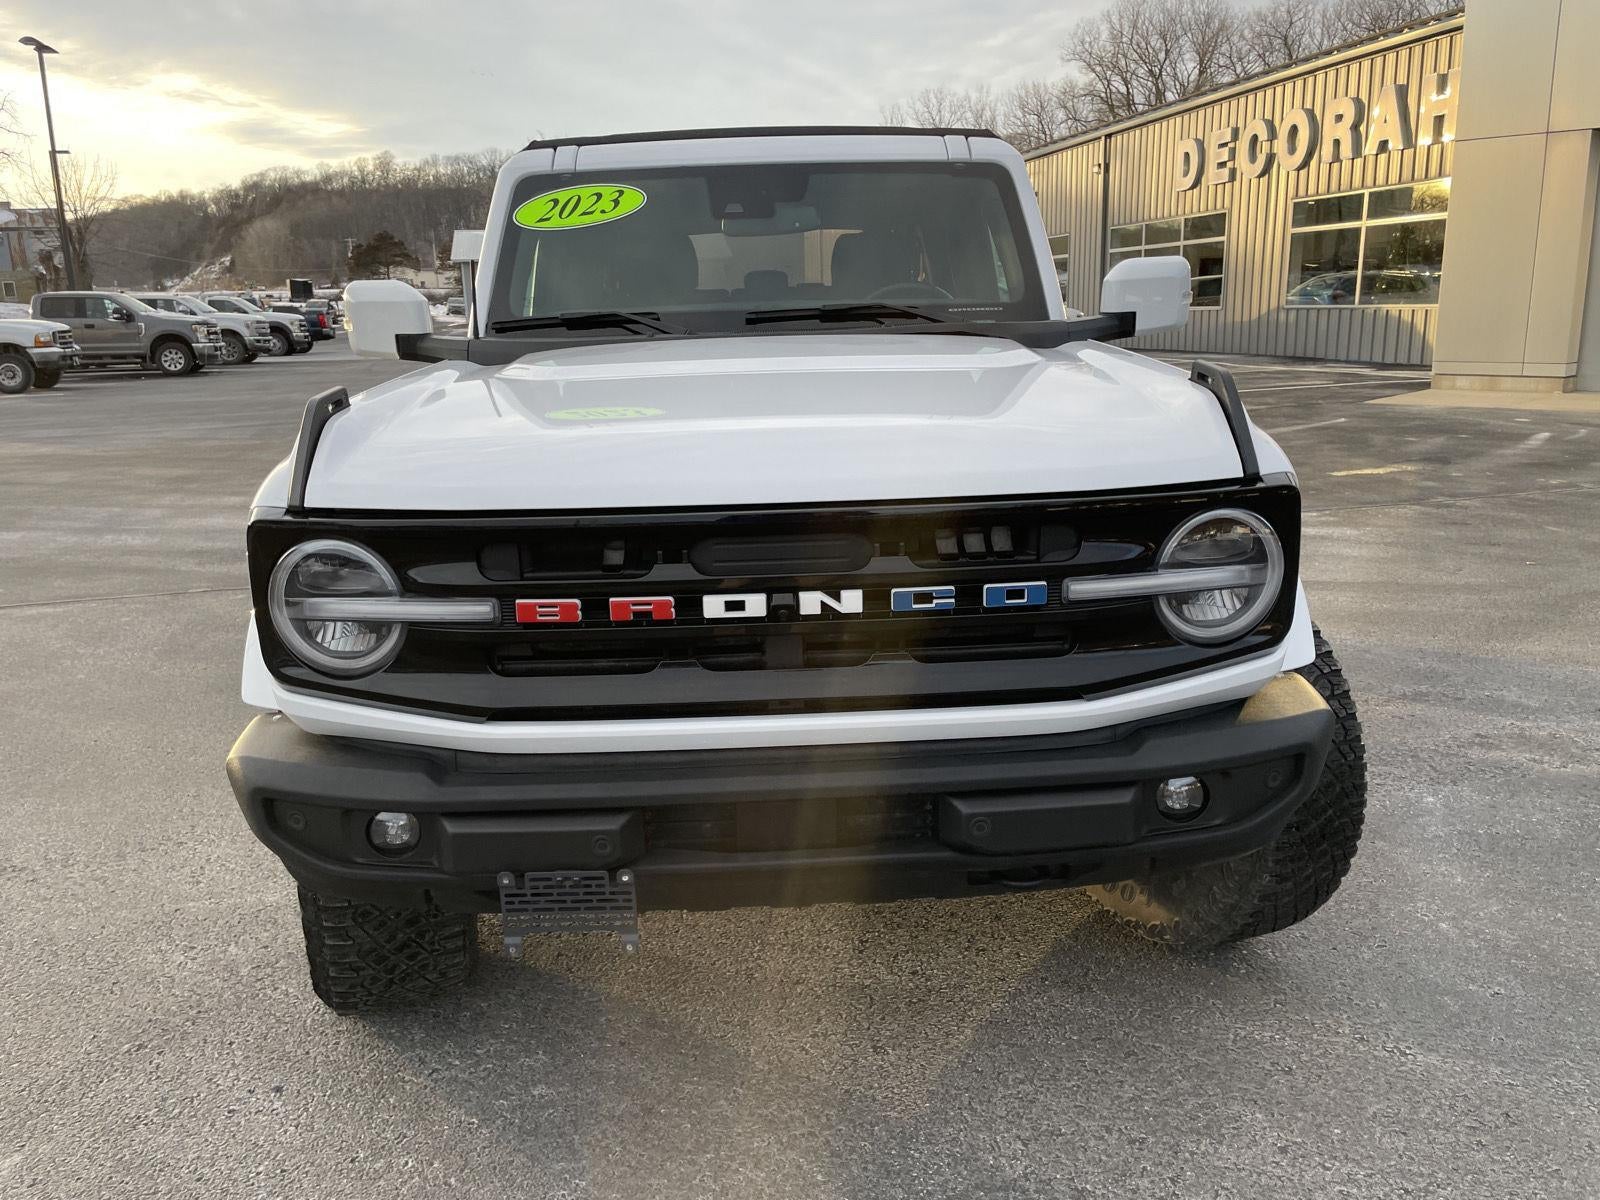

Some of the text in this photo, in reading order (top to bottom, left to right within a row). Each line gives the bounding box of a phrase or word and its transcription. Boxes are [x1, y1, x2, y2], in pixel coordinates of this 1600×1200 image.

[1176, 67, 1461, 192] DECORAH
[535, 189, 625, 224] 2023
[515, 580, 1048, 623] BRONCO
